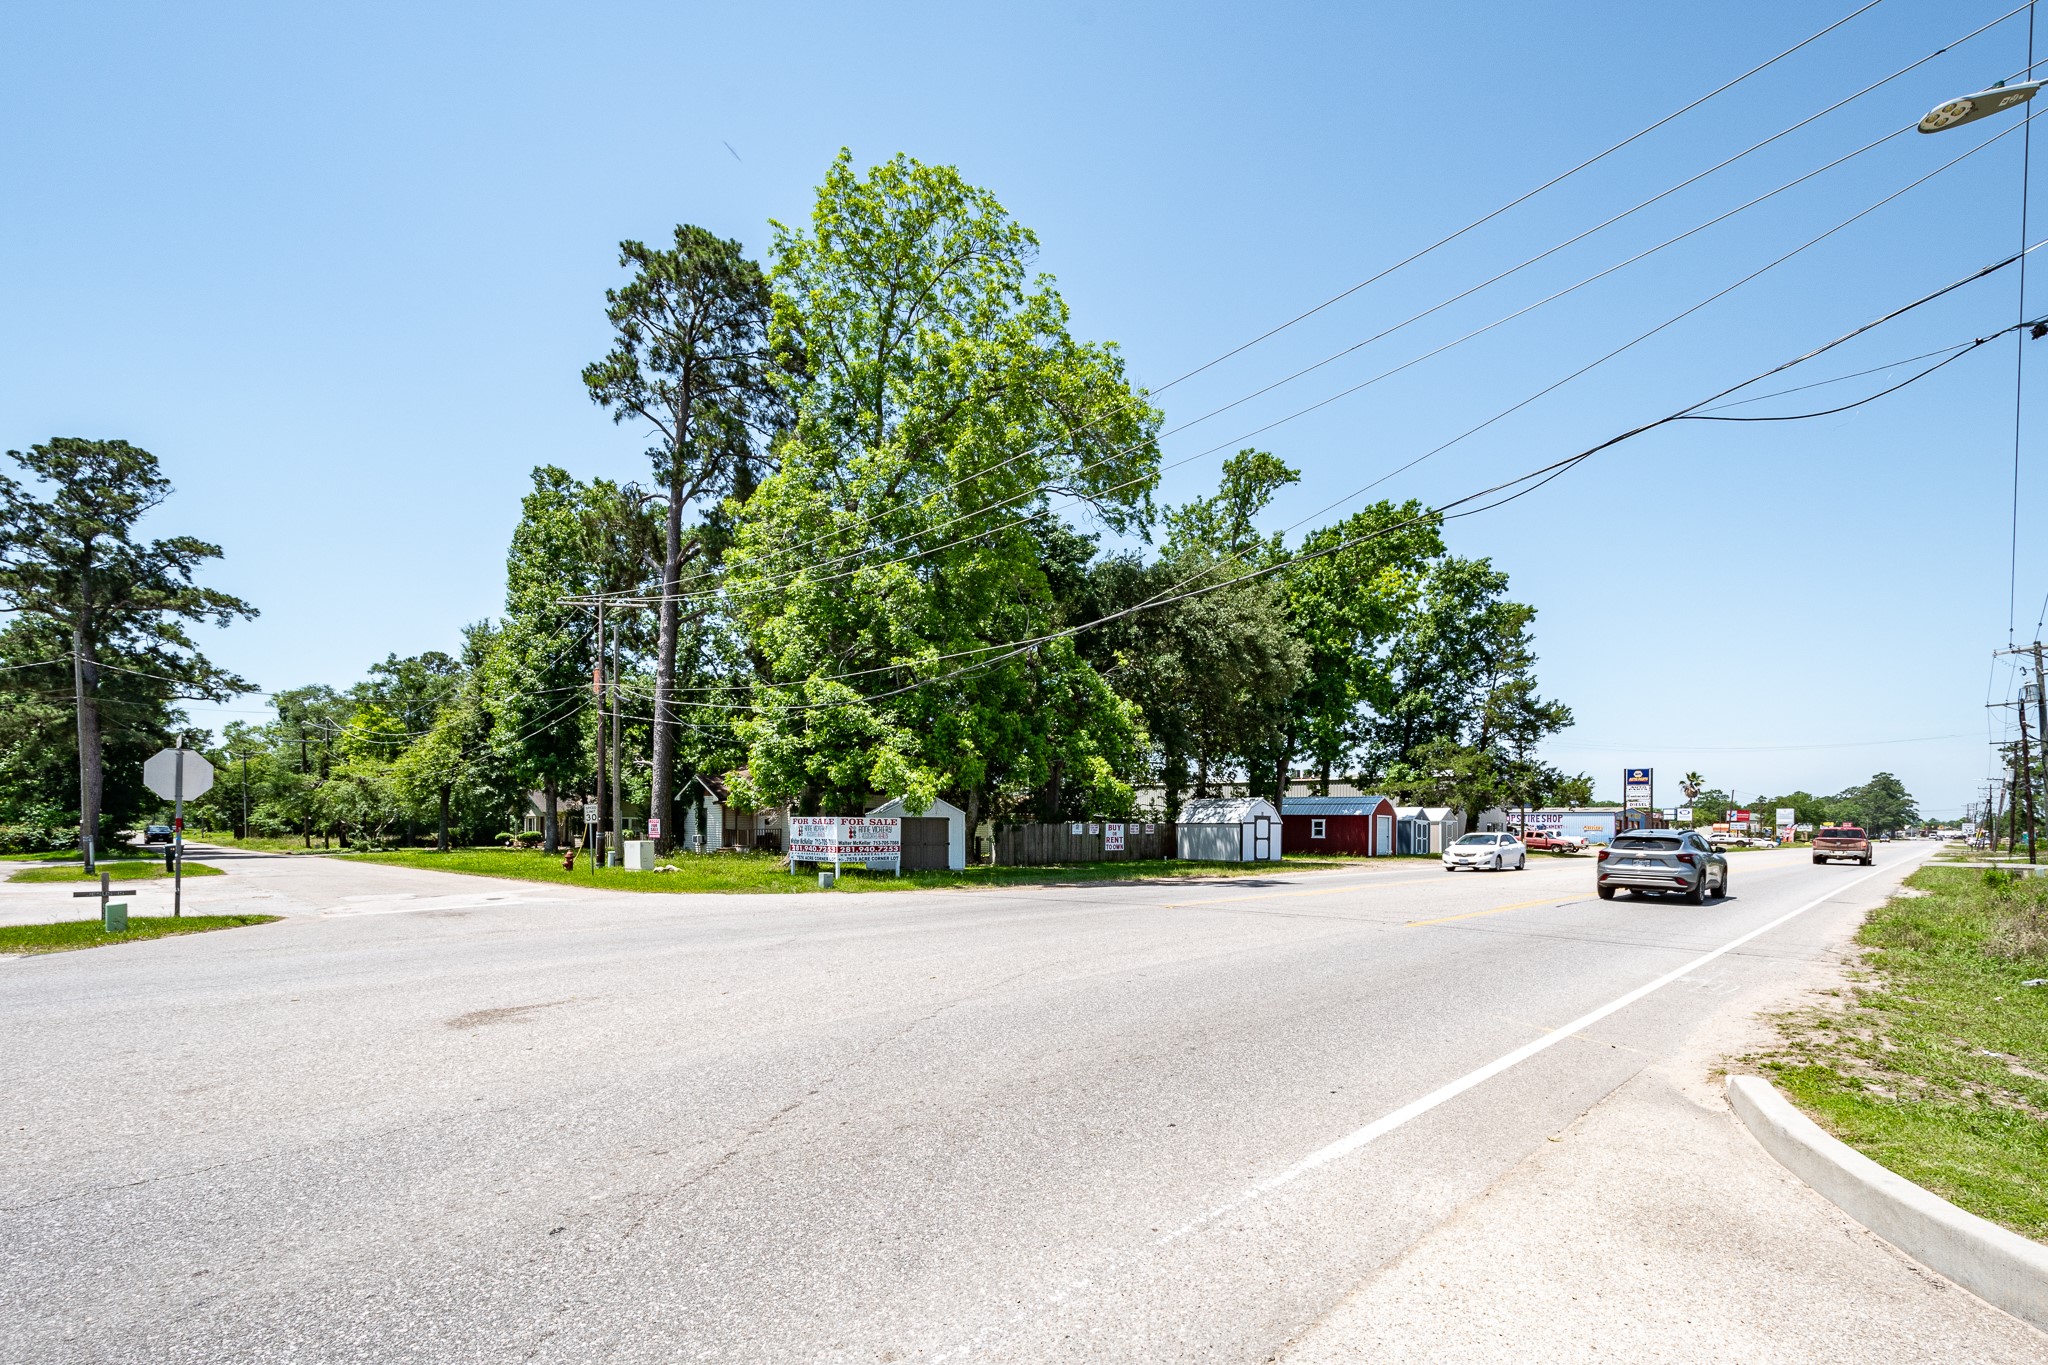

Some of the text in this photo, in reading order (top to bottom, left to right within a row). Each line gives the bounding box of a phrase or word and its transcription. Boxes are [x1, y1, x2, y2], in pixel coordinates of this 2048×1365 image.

[1523, 815, 1540, 823] TIRE
[1541, 815, 1563, 823] SHOP
[791, 845, 836, 853] 281.940.7253
